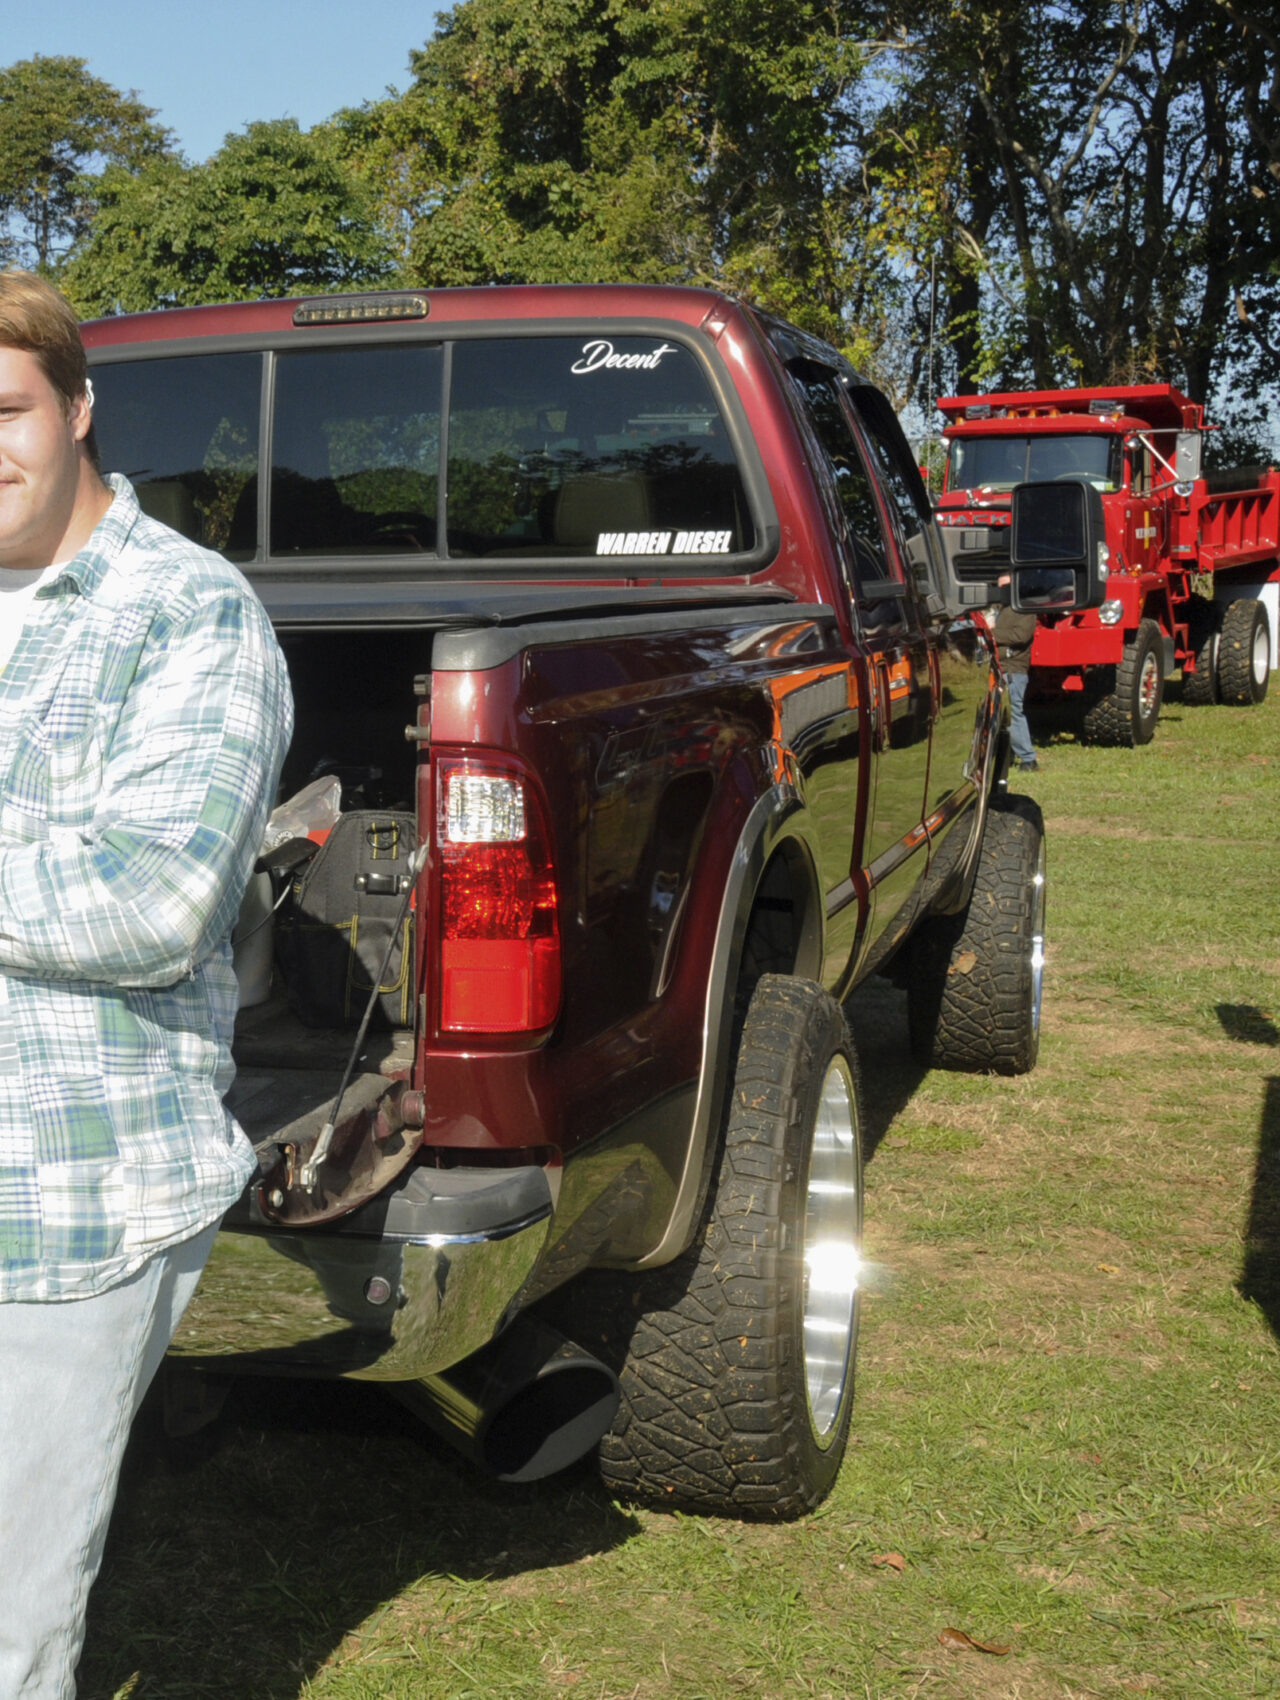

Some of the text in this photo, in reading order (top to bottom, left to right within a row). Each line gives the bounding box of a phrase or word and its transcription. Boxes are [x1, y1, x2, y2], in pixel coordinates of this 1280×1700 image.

[571, 340, 678, 374] Decent
[936, 513, 1008, 525] MACK
[596, 531, 732, 555] WARREN DIESEL
